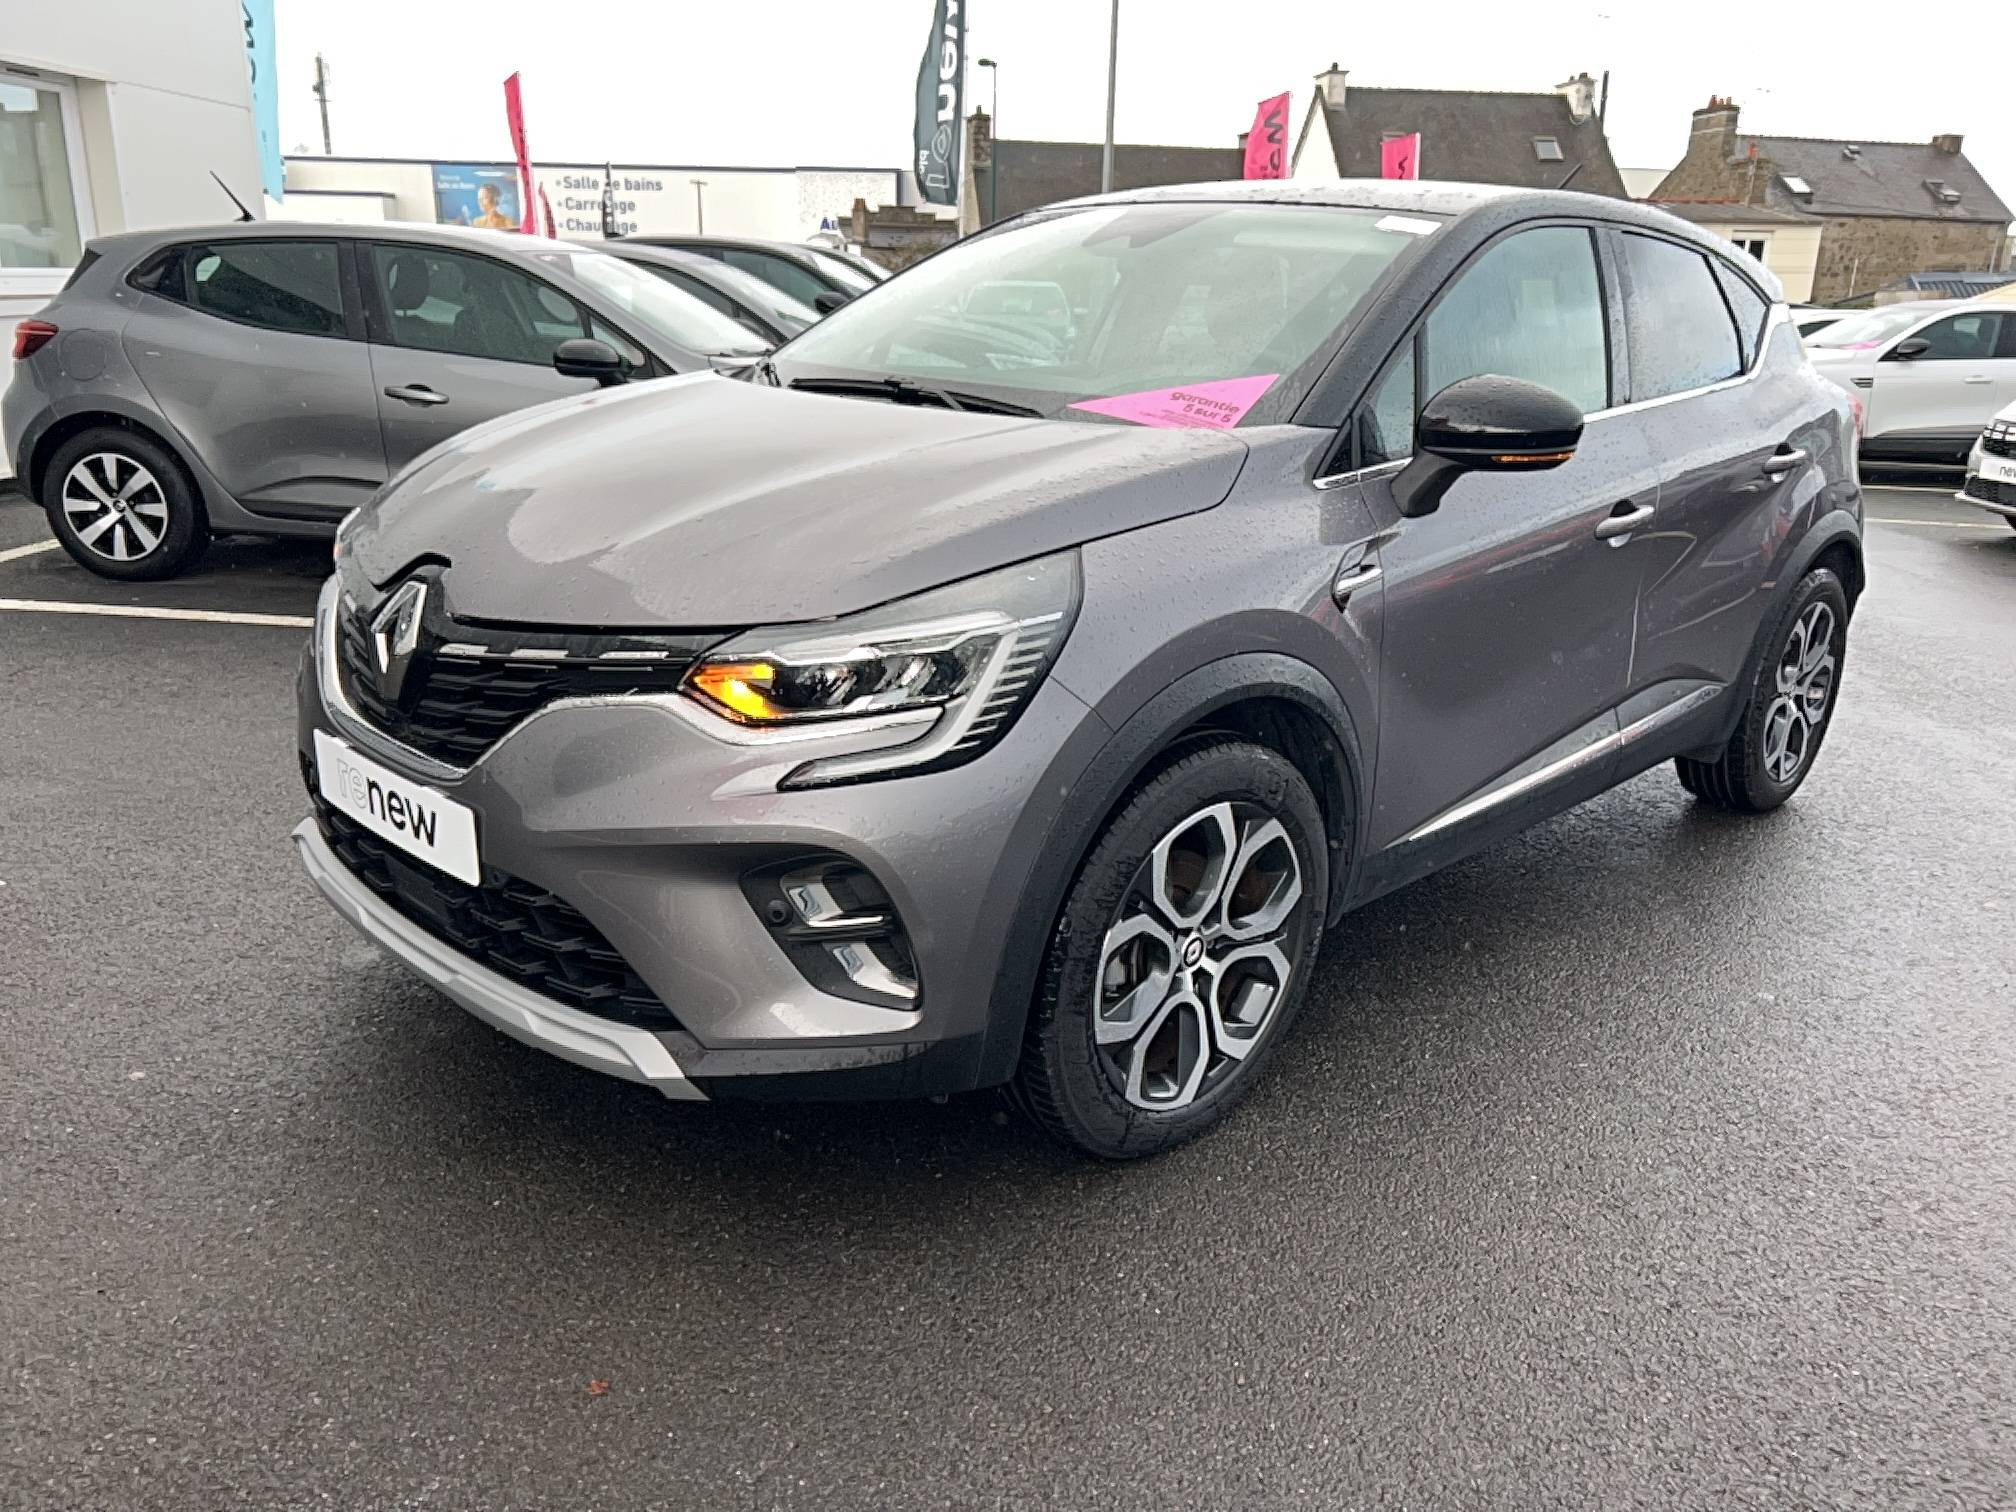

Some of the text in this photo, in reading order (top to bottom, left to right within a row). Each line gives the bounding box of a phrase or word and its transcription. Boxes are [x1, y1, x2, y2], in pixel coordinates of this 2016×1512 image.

[563, 176, 599, 189] Salle
[624, 178, 663, 191] bains
[1170, 392, 1239, 413] garantie
[1183, 404, 1195, 412] 5
[1194, 408, 1221, 418] sur
